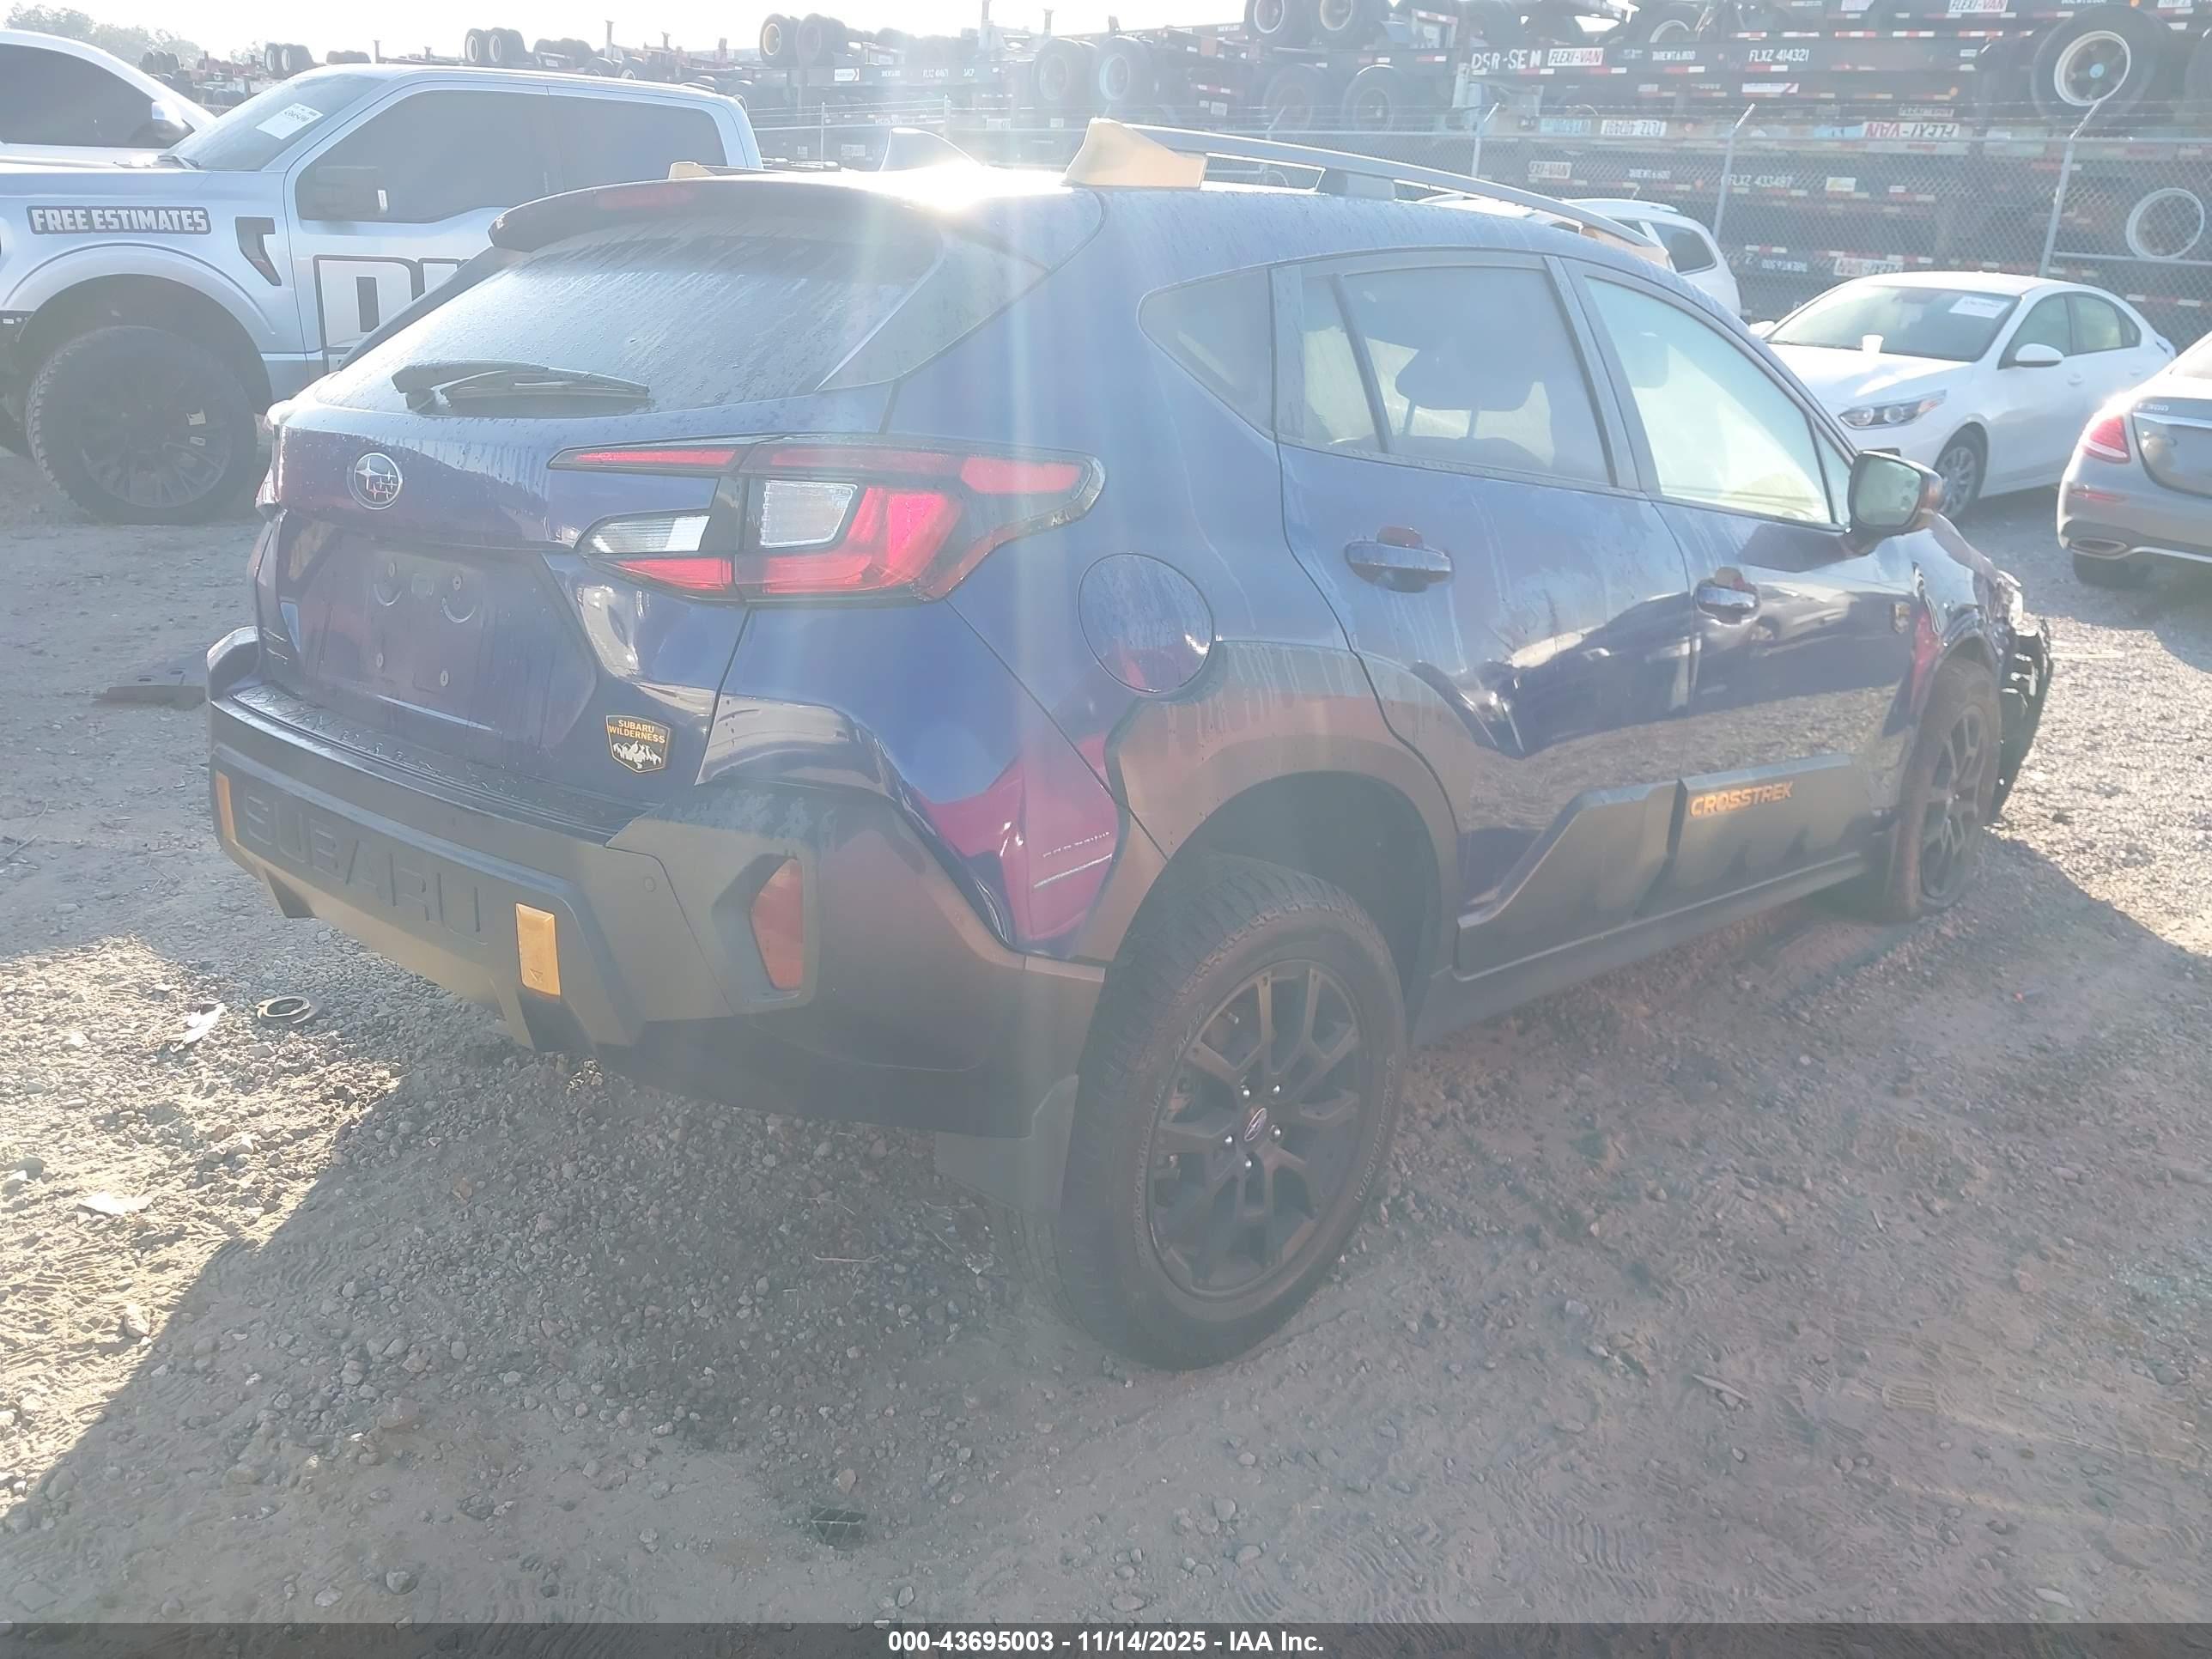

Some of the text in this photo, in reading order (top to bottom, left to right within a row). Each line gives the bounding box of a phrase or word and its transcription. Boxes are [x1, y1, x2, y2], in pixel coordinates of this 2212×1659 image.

[1748, 49, 1773, 62] FLXZ
[31, 208, 210, 234] FREE ESTIMATES
[609, 726, 666, 744] WILDERNESS
[617, 720, 655, 733] SUBARU
[1689, 781, 1794, 818] CROSSTREK
[242, 793, 489, 946] SUBARU
